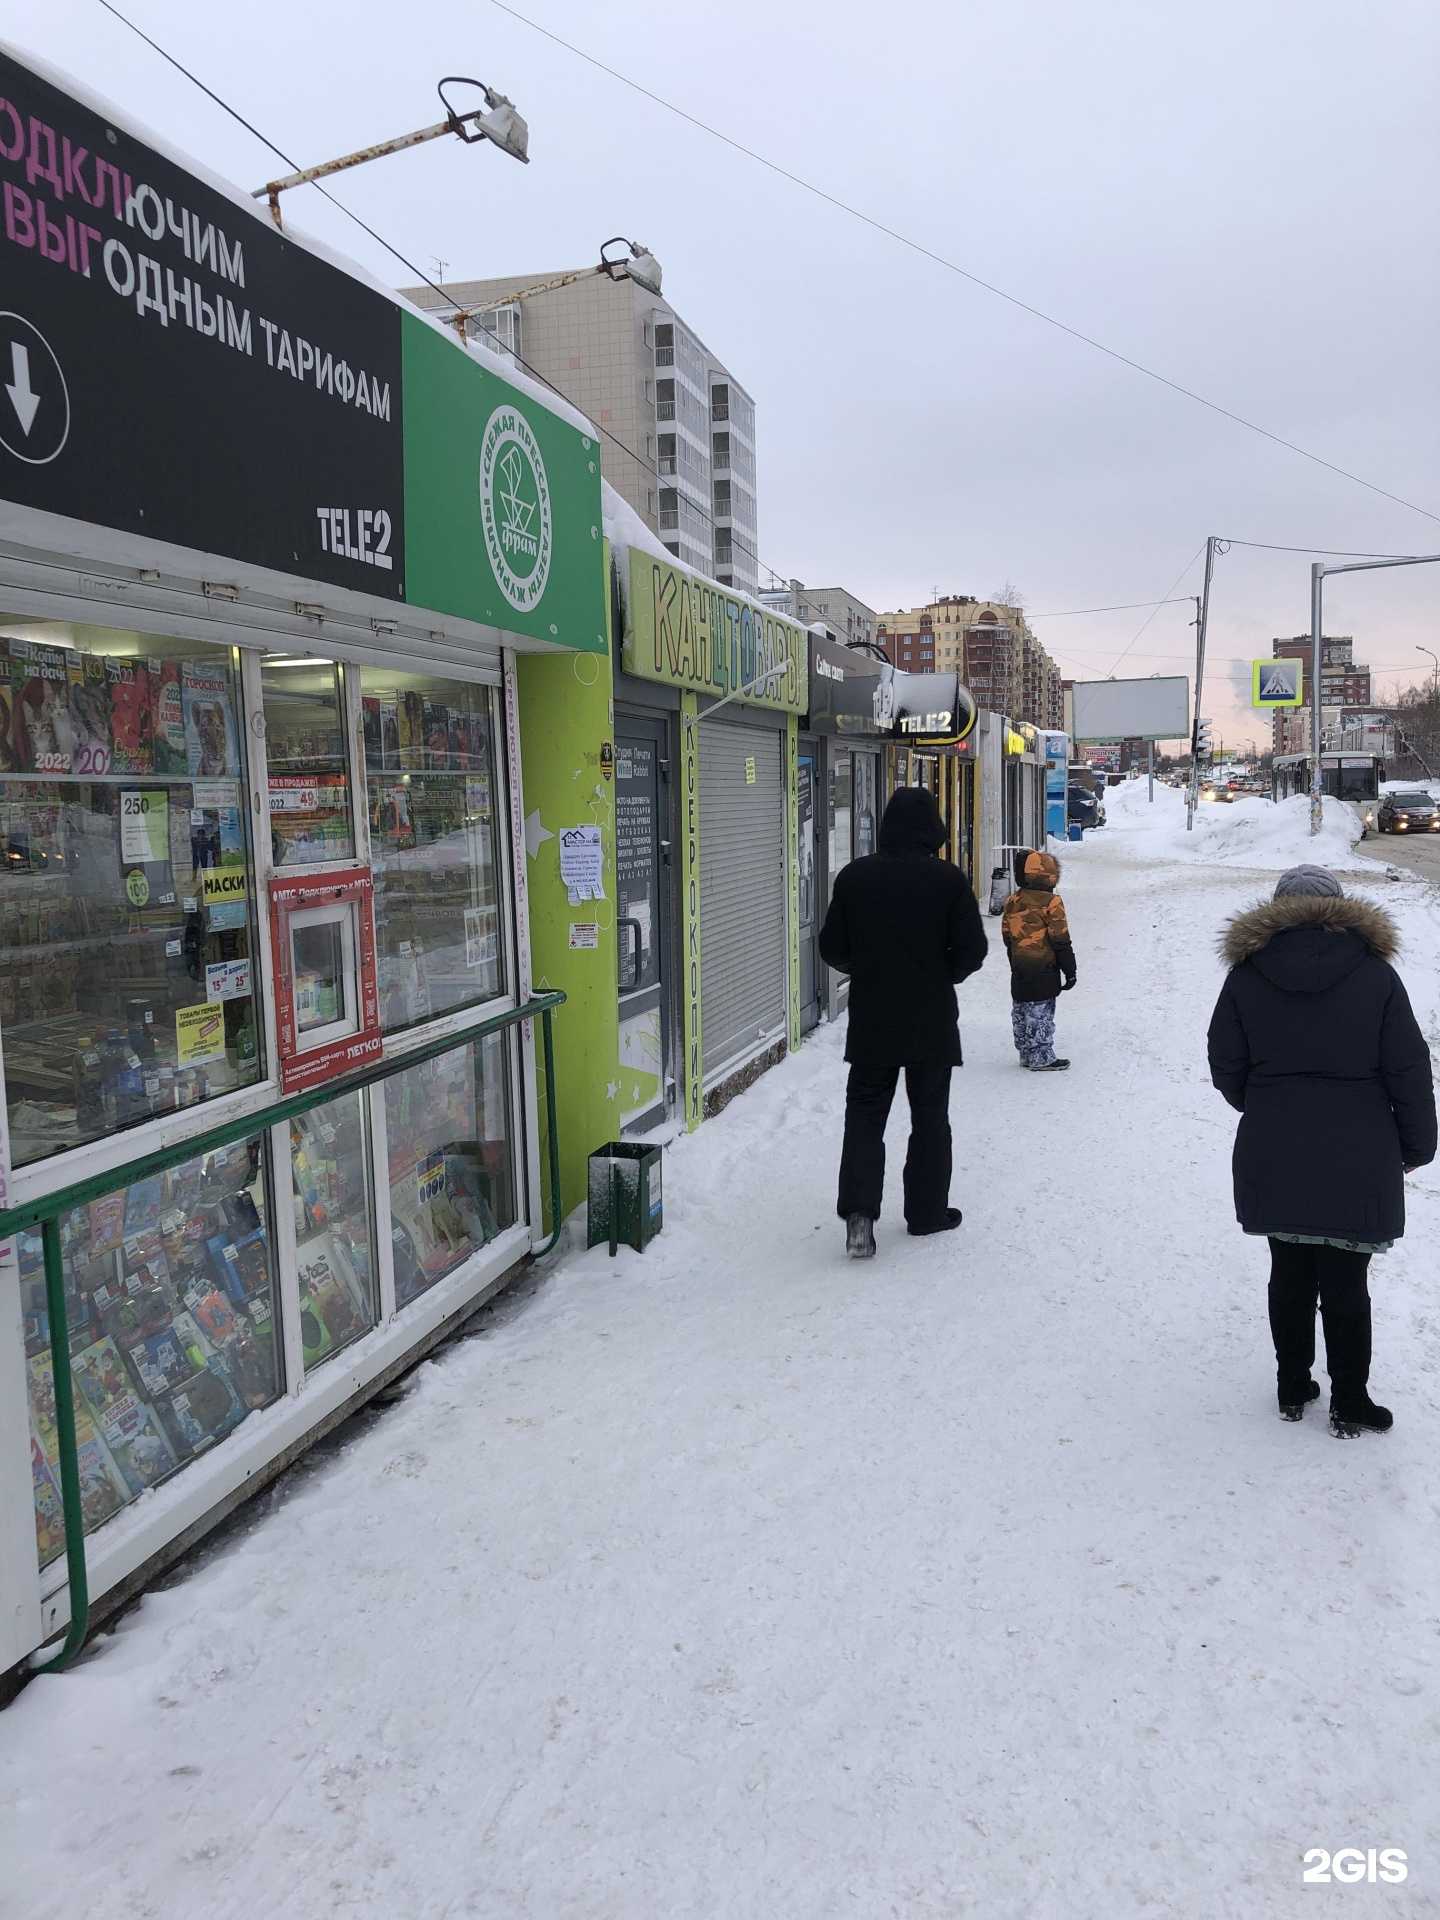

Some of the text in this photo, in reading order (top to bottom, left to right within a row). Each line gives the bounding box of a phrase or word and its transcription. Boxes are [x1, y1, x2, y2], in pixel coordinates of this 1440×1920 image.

[3, 181, 391, 422] ВЫГОДНЫМ ТАРИФАМ
[484, 415, 548, 502] СВЕЖАЯ ПРЕССА
[317, 507, 393, 570] TELE2
[483, 498, 549, 604] ГАЗЕТЫ ЖУРНАЛЫ
[652, 564, 801, 706] КАНЦТОВАРЫ
[900, 711, 952, 733] TELE2
[35, 752, 72, 770] 2022
[124, 797, 150, 815] 250
[204, 875, 245, 894] МАСКИ
[277, 888, 296, 901] МТС
[354, 879, 371, 889] МТС
[686, 712, 699, 1121] КСЕРОКОПИЯ
[347, 1037, 382, 1060] ЛЕГКО!
